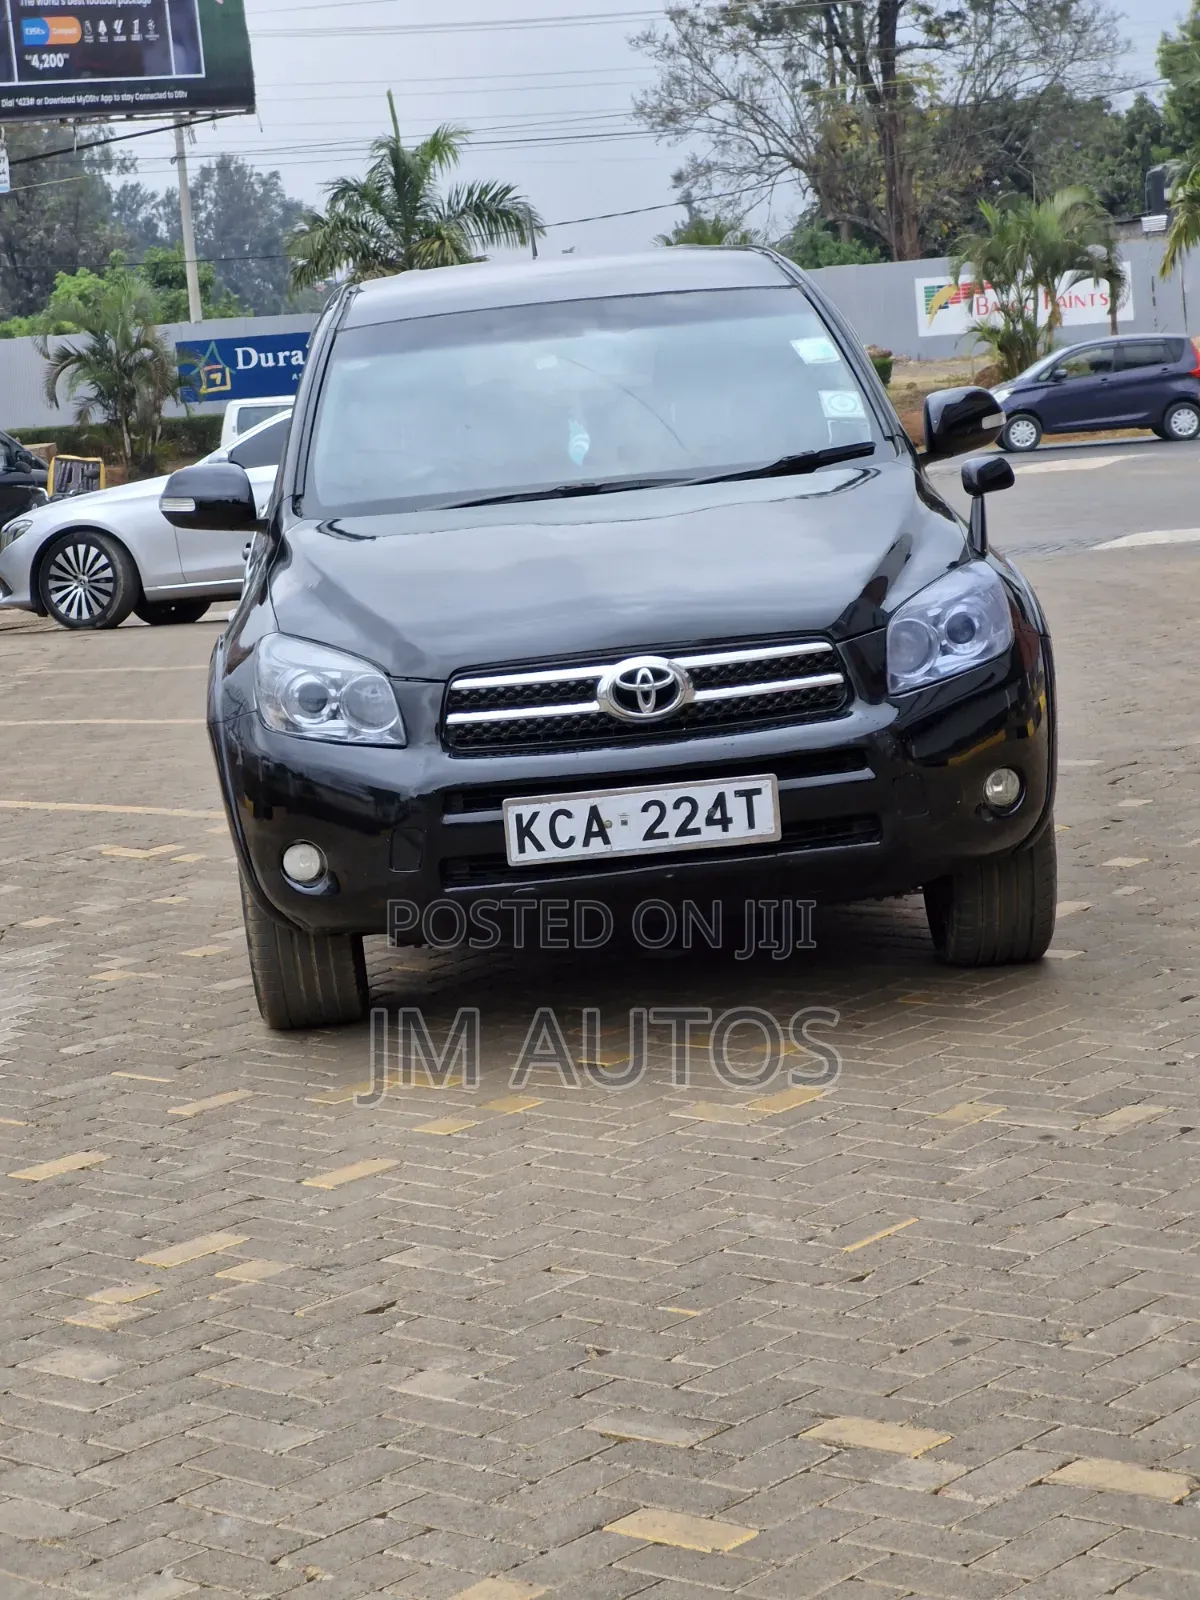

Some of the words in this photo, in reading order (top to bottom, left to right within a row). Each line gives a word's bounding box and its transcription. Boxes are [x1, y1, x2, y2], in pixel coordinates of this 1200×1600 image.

[1, 97, 14, 108] Dial
[36, 98, 44, 106] or
[44, 95, 76, 105] Download
[76, 95, 99, 106] MyDStv
[100, 94, 113, 104] App
[113, 94, 120, 102] to
[121, 93, 135, 104] stay
[135, 91, 167, 101] Connected
[167, 91, 174, 99] to
[174, 90, 188, 99] DStv
[234, 344, 309, 370] Dura
[515, 804, 611, 854] KCA
[640, 788, 763, 841] 224T
